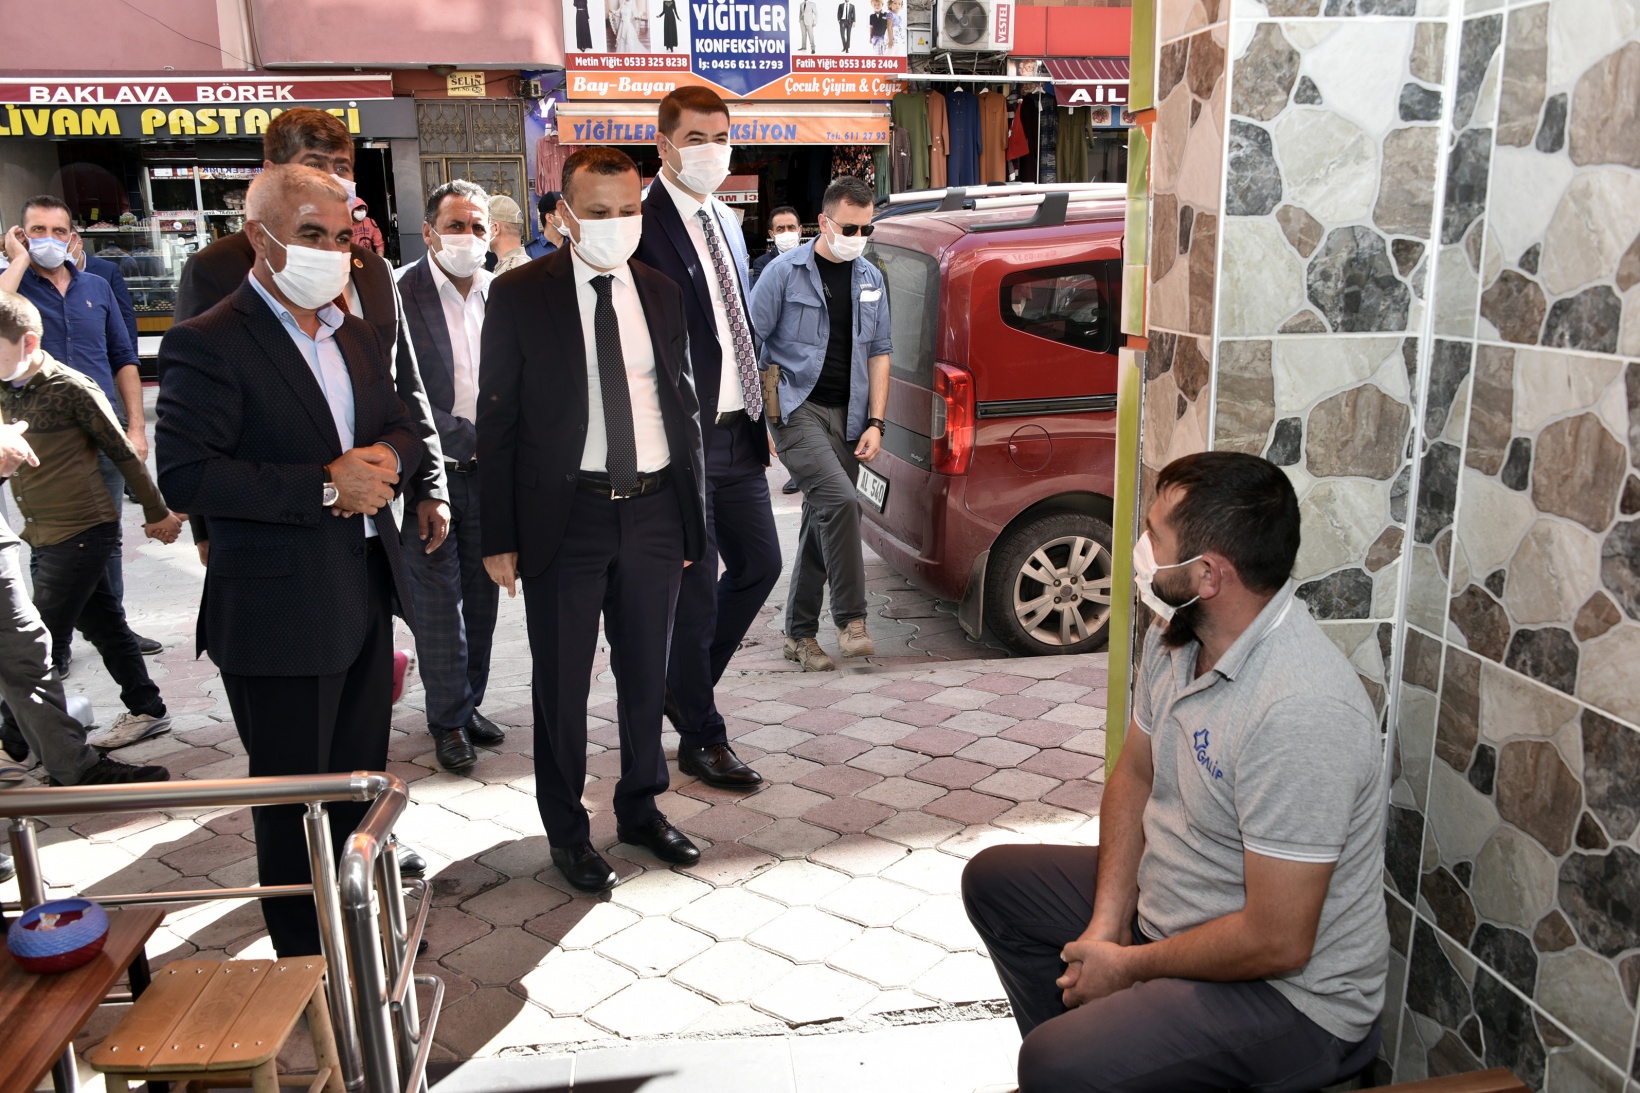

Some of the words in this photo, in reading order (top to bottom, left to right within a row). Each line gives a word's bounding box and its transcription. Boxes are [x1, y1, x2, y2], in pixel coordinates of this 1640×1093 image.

[997, 4, 1008, 43] VESTEL
[695, 36, 785, 53] KONFEKSİYON
[575, 56, 598, 67] Metin
[600, 57, 622, 69] Yiğit:
[624, 57, 646, 67] 0533
[648, 57, 664, 67] 325
[666, 57, 688, 67] 8238
[711, 60, 737, 69] 0456
[738, 60, 757, 69] 611
[759, 60, 783, 69] 2793
[796, 59, 815, 69] Fatih
[817, 59, 838, 70] Yiğit:
[839, 59, 860, 69] 0553
[862, 59, 876, 69] 186
[878, 60, 898, 69] 2404
[29, 86, 174, 103] BAKLAVA
[196, 83, 295, 101] BÖREK
[573, 76, 676, 95] Bay-Bayan
[785, 77, 819, 95] Çocuk
[822, 78, 856, 96] Giyim
[859, 78, 869, 93] &
[141, 101, 361, 135] PASTAİ
[573, 119, 656, 140] YİĞİTLER
[871, 478, 885, 504] 540
